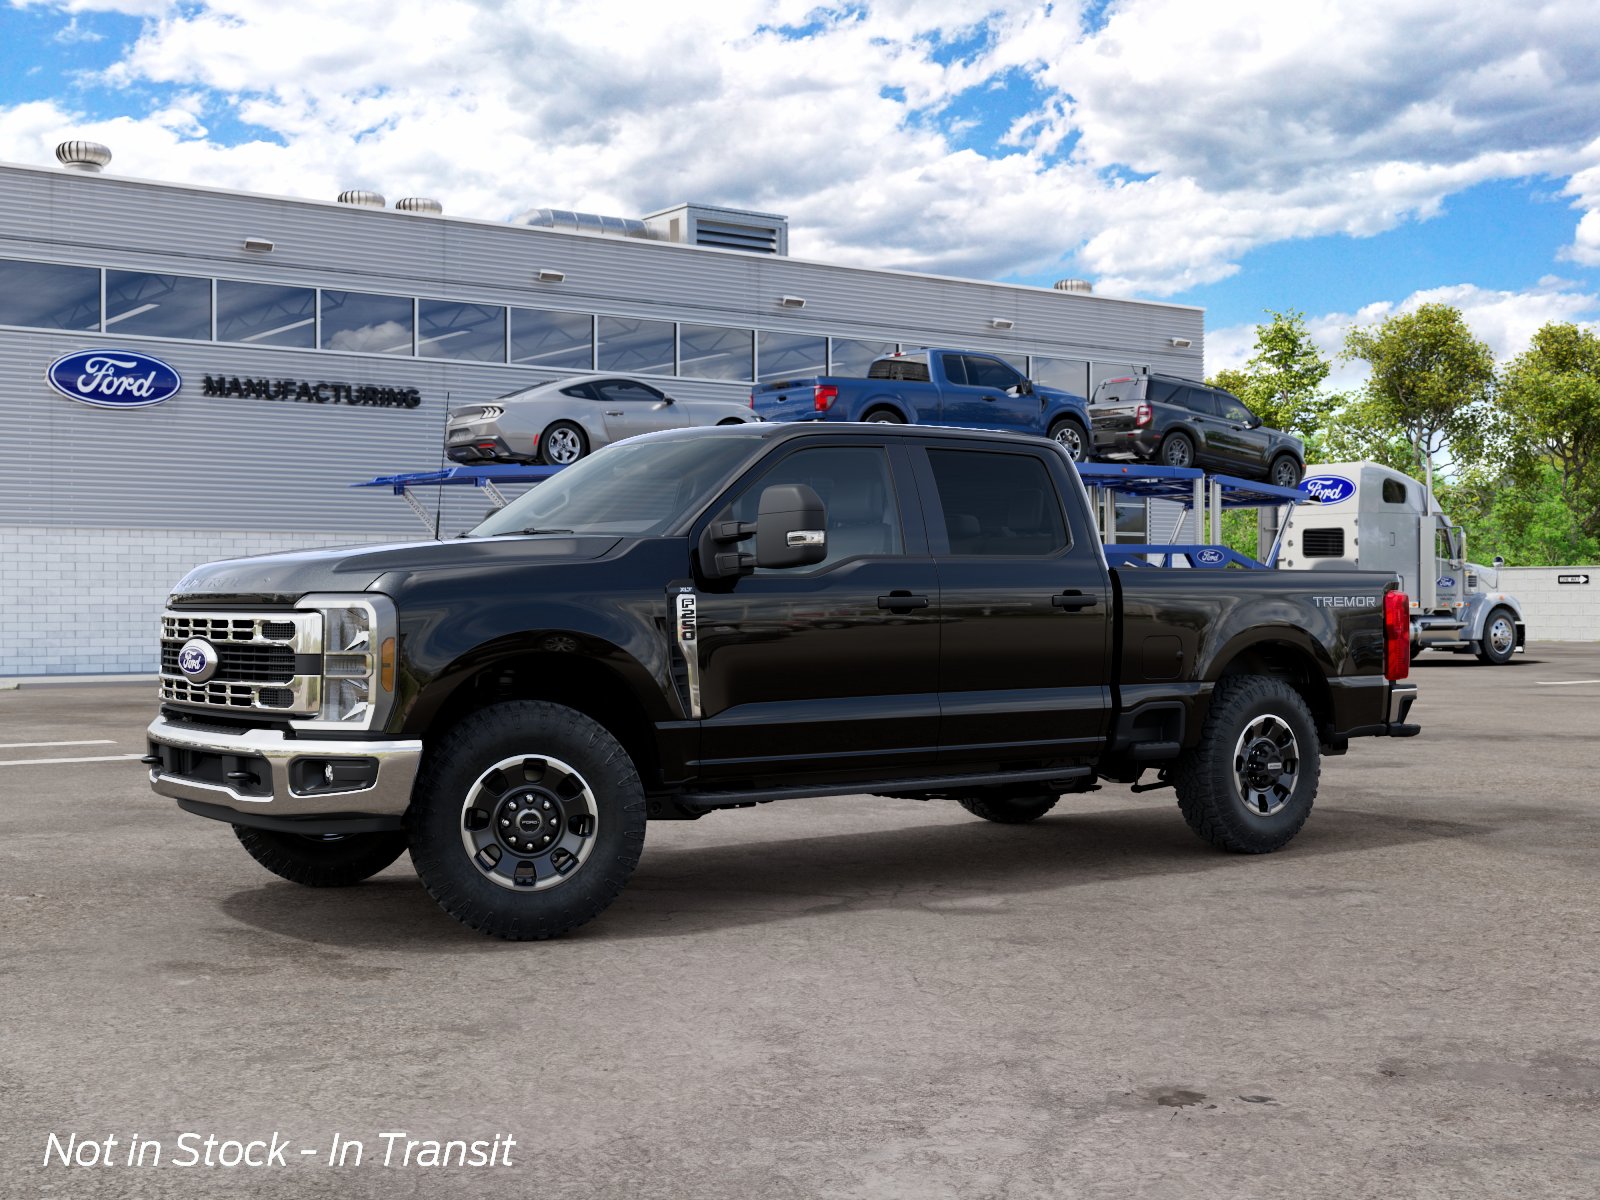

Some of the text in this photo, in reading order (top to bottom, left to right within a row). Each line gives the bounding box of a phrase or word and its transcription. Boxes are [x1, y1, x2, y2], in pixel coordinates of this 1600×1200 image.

[77, 357, 157, 397] Ford
[203, 374, 422, 408] MANUFACTURING
[1306, 480, 1343, 500] Ford
[1201, 550, 1220, 562] Ford
[1312, 596, 1376, 608] TREMOR
[183, 650, 202, 670] Ford
